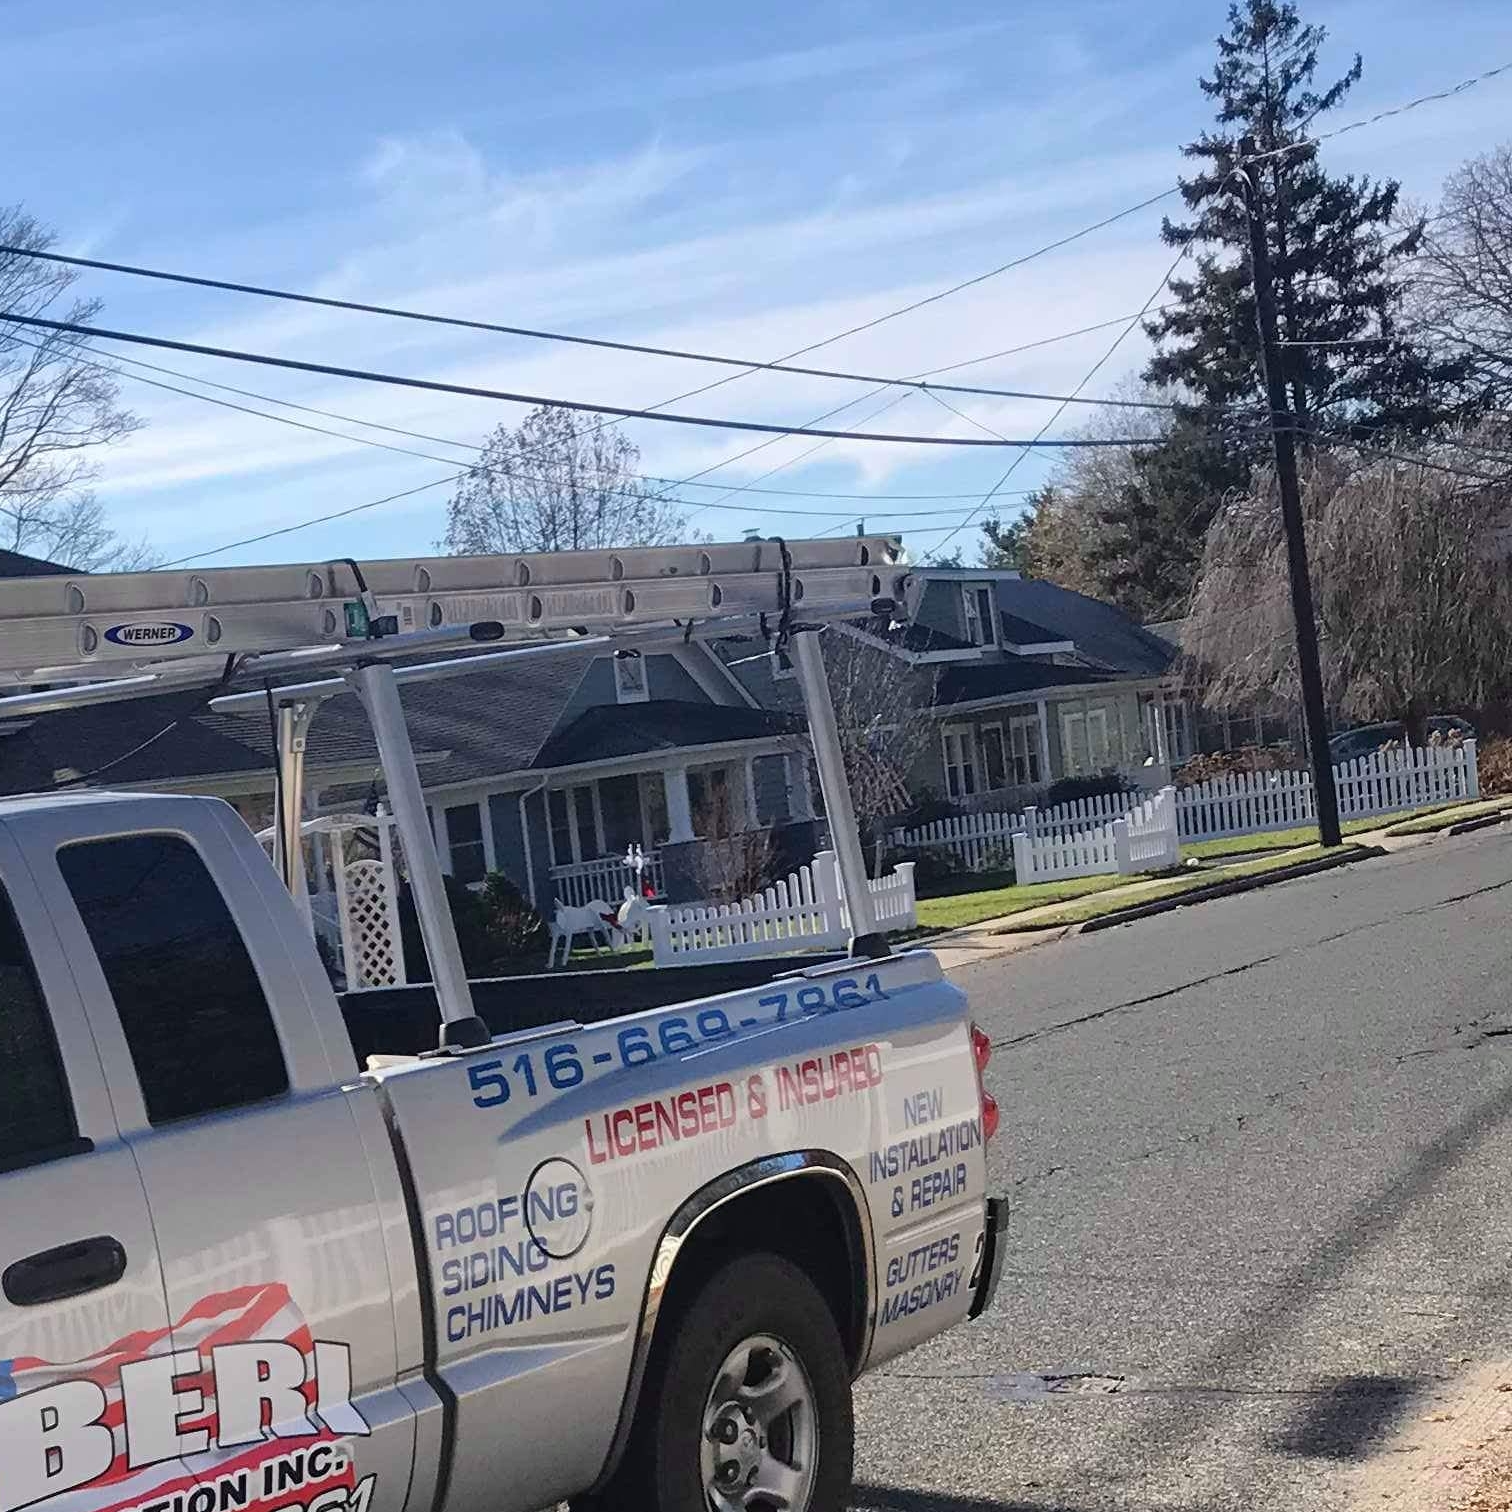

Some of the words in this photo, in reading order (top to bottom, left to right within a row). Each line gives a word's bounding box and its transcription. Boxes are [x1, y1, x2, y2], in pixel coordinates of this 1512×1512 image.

[123, 627, 176, 641] WERNER
[467, 973, 890, 1108] 516-669-7861
[585, 1081, 737, 1164] LICENSED
[747, 1074, 769, 1119] &
[775, 1043, 883, 1112] INSURED
[903, 1087, 944, 1129] NEW
[868, 1117, 982, 1185] INSTALLATION
[435, 1181, 580, 1251] ROOFING
[890, 1184, 904, 1219] &
[910, 1162, 967, 1216] REPAIR
[442, 1236, 549, 1297] SIDING
[886, 1232, 960, 1288] GUTTERS
[446, 1263, 616, 1343] CHIMNEYS
[879, 1265, 965, 1329] MASONRY
[261, 1442, 346, 1502] INC.
